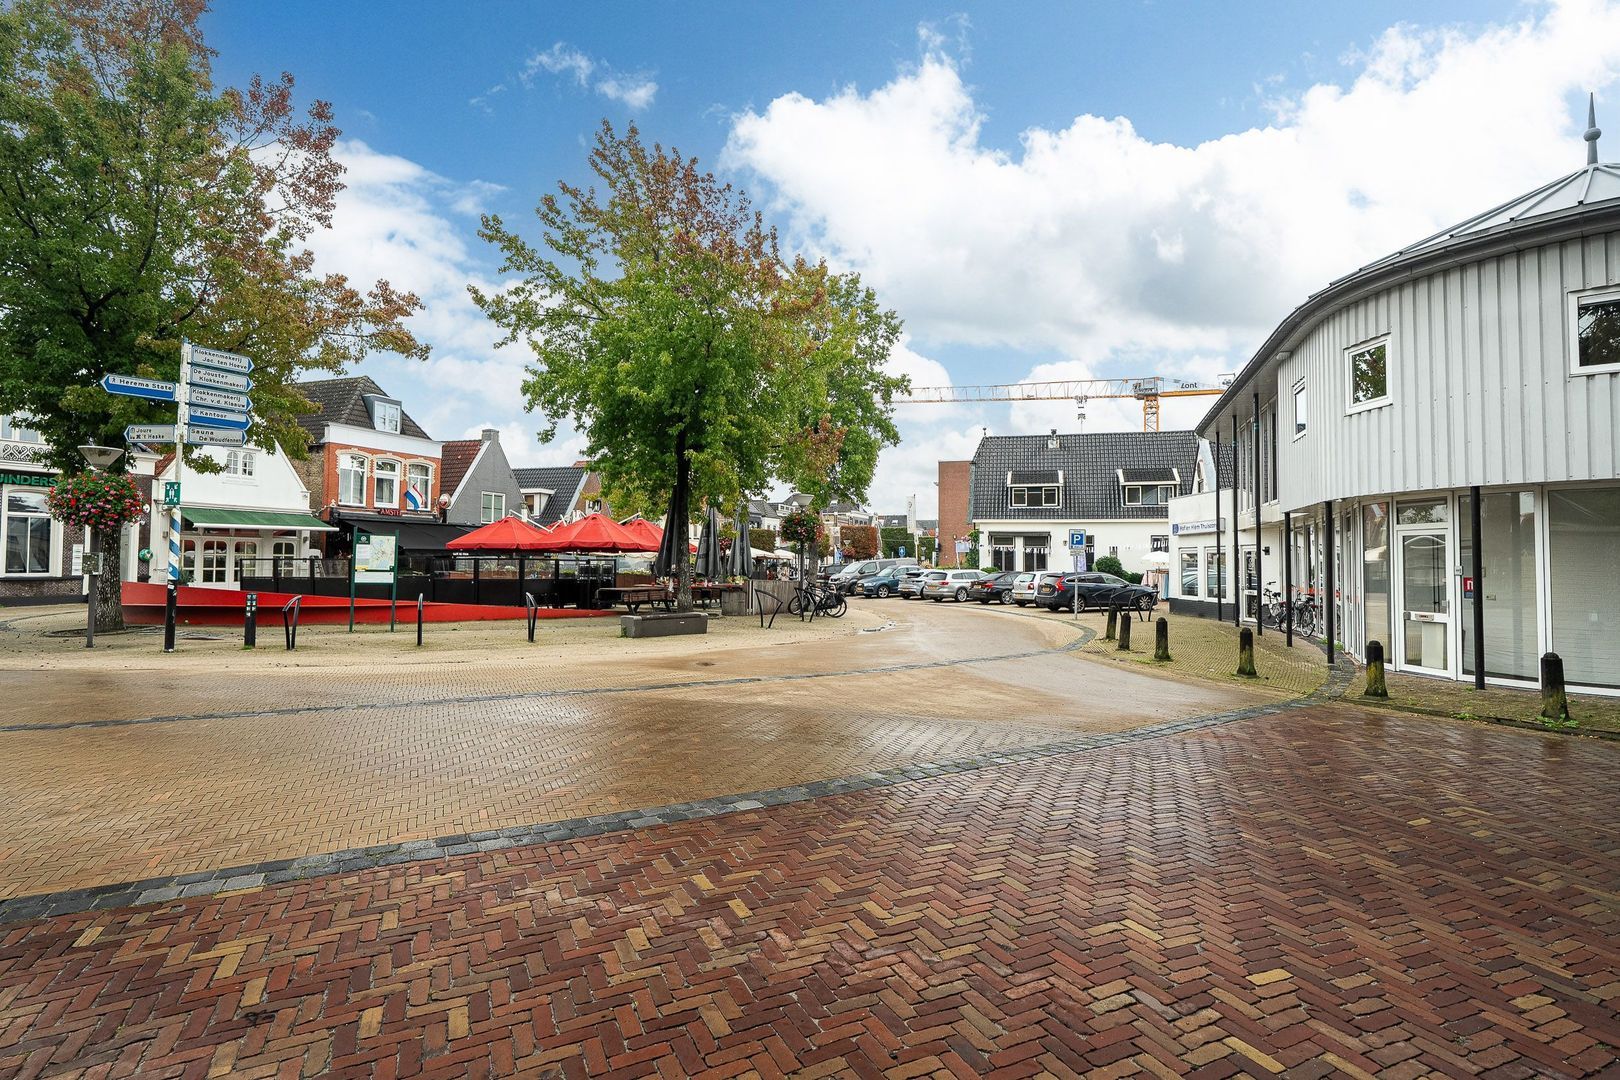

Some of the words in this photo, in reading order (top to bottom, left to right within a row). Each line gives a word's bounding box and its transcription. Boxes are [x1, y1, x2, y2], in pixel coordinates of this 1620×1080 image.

[194, 349, 242, 363] Klokkenmakerij
[203, 371, 228, 379] Jouster
[120, 378, 150, 388] Herema
[199, 376, 246, 390] Klokkenmakerij
[192, 389, 241, 402] Klokkenmakerij
[1074, 534, 1080, 544] P
